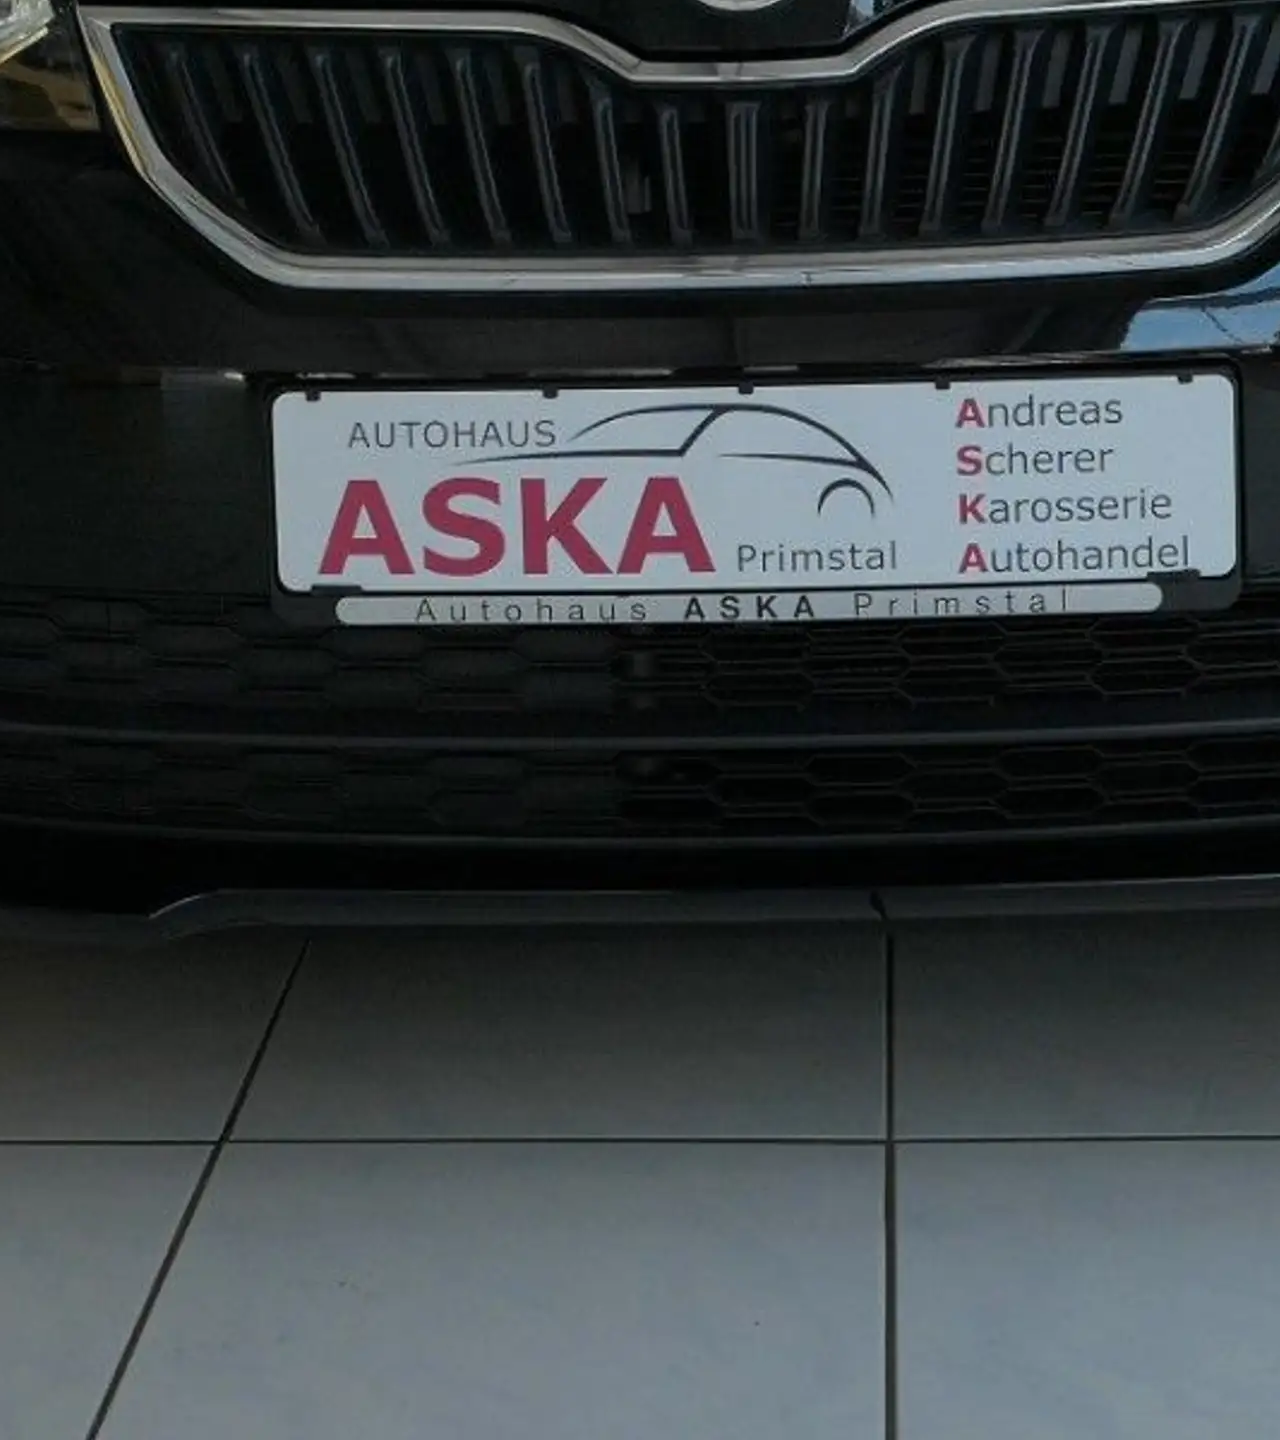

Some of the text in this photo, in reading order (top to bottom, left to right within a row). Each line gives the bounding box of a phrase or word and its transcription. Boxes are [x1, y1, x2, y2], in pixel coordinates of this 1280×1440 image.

[955, 397, 1123, 429] Andreas
[347, 420, 557, 449] AUTOHAUS
[957, 443, 1114, 476] Scherer
[958, 489, 1173, 525] Karosserie
[317, 475, 897, 577] ASKA Primstal
[958, 535, 1190, 574] Autohandel
[414, 589, 1068, 623] Autohaus ASKA Primstal
